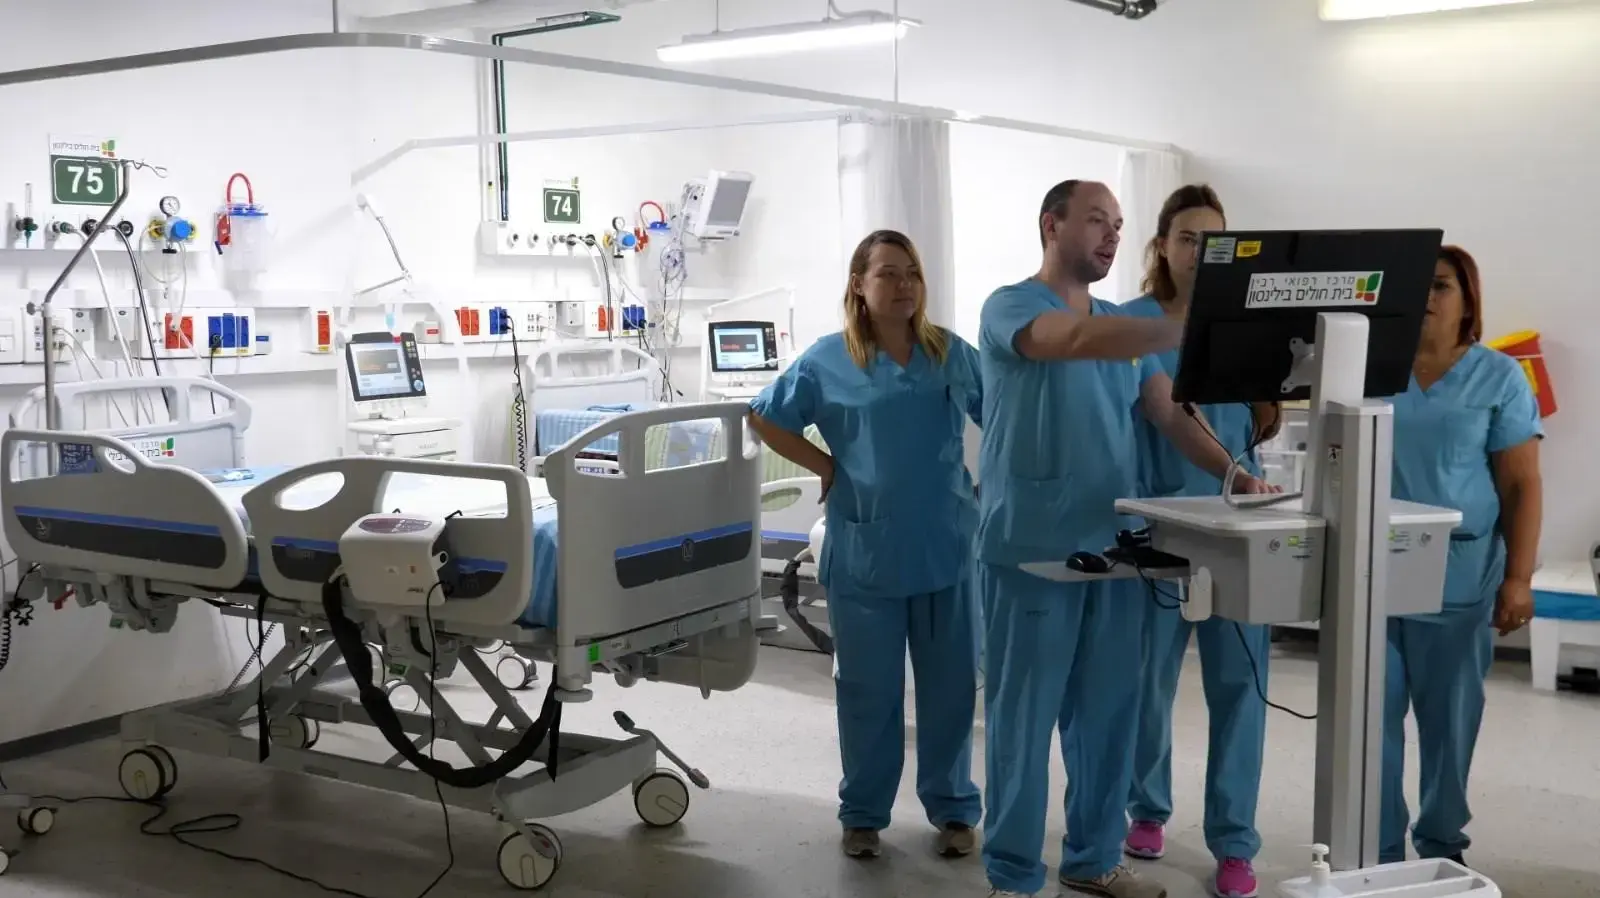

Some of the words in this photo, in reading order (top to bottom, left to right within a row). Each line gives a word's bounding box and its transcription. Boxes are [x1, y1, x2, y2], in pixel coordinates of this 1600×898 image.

[67, 166, 104, 195] 75
[551, 195, 573, 217] 74
[1250, 277, 1276, 290] רבין
[1284, 276, 1317, 287] רפואי
[1326, 275, 1355, 285] מרכז
[1247, 286, 1292, 306] בילינסון
[1296, 285, 1328, 301] חולים
[1331, 287, 1353, 300] בית
